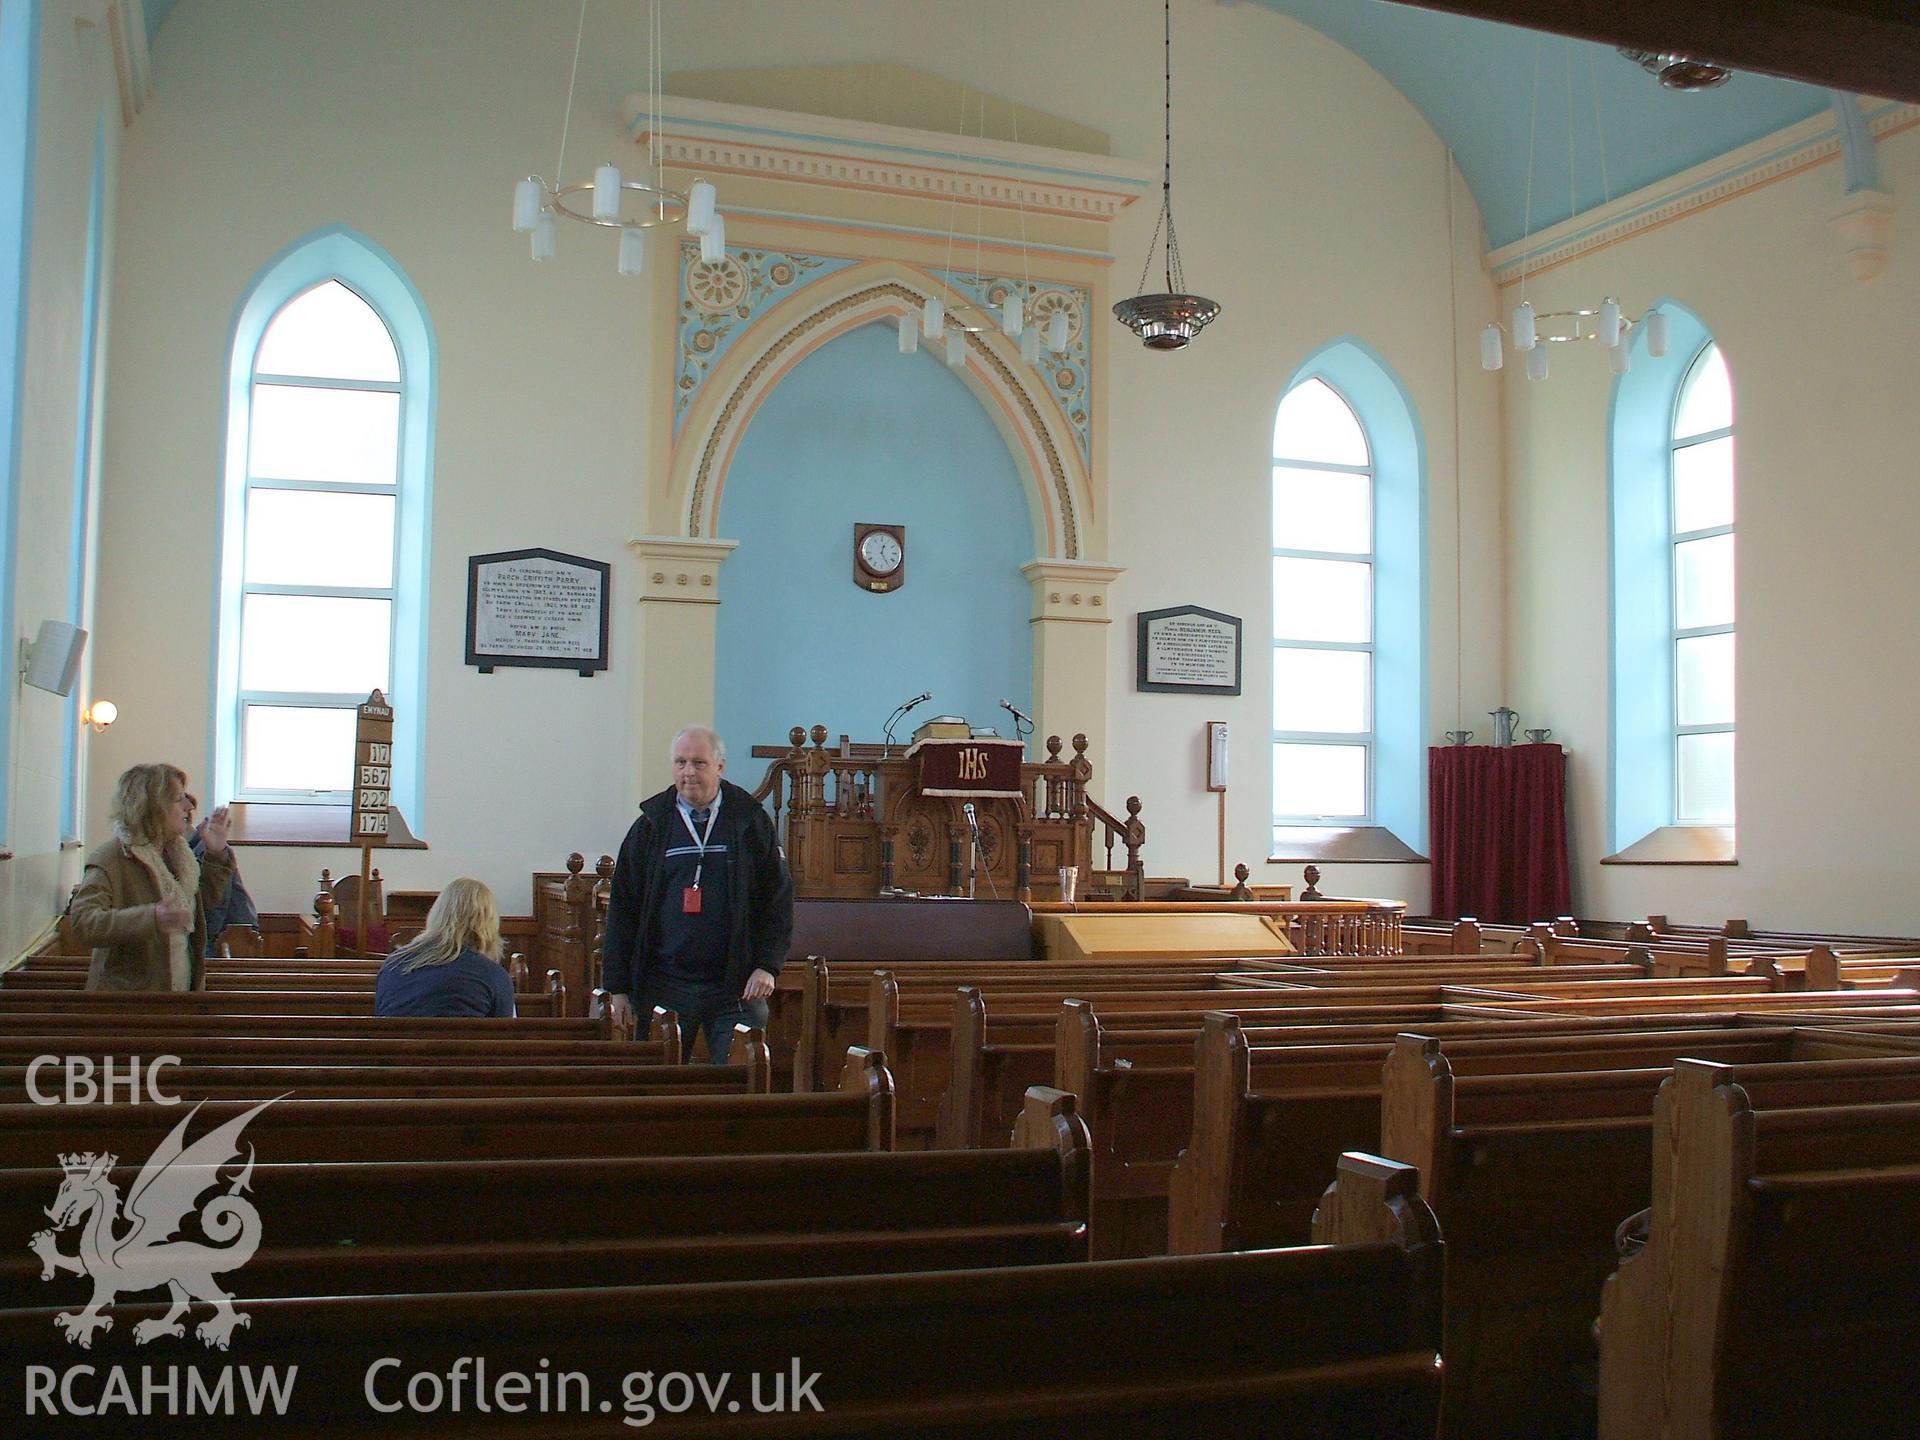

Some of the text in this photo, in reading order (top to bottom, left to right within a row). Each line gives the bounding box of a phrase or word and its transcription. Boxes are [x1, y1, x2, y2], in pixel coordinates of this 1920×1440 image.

[363, 705, 389, 716] EMYNAU
[372, 745, 388, 762] 17
[958, 748, 989, 780] IHS
[363, 768, 388, 786] 567
[361, 791, 387, 808] 222
[362, 815, 386, 832] 174
